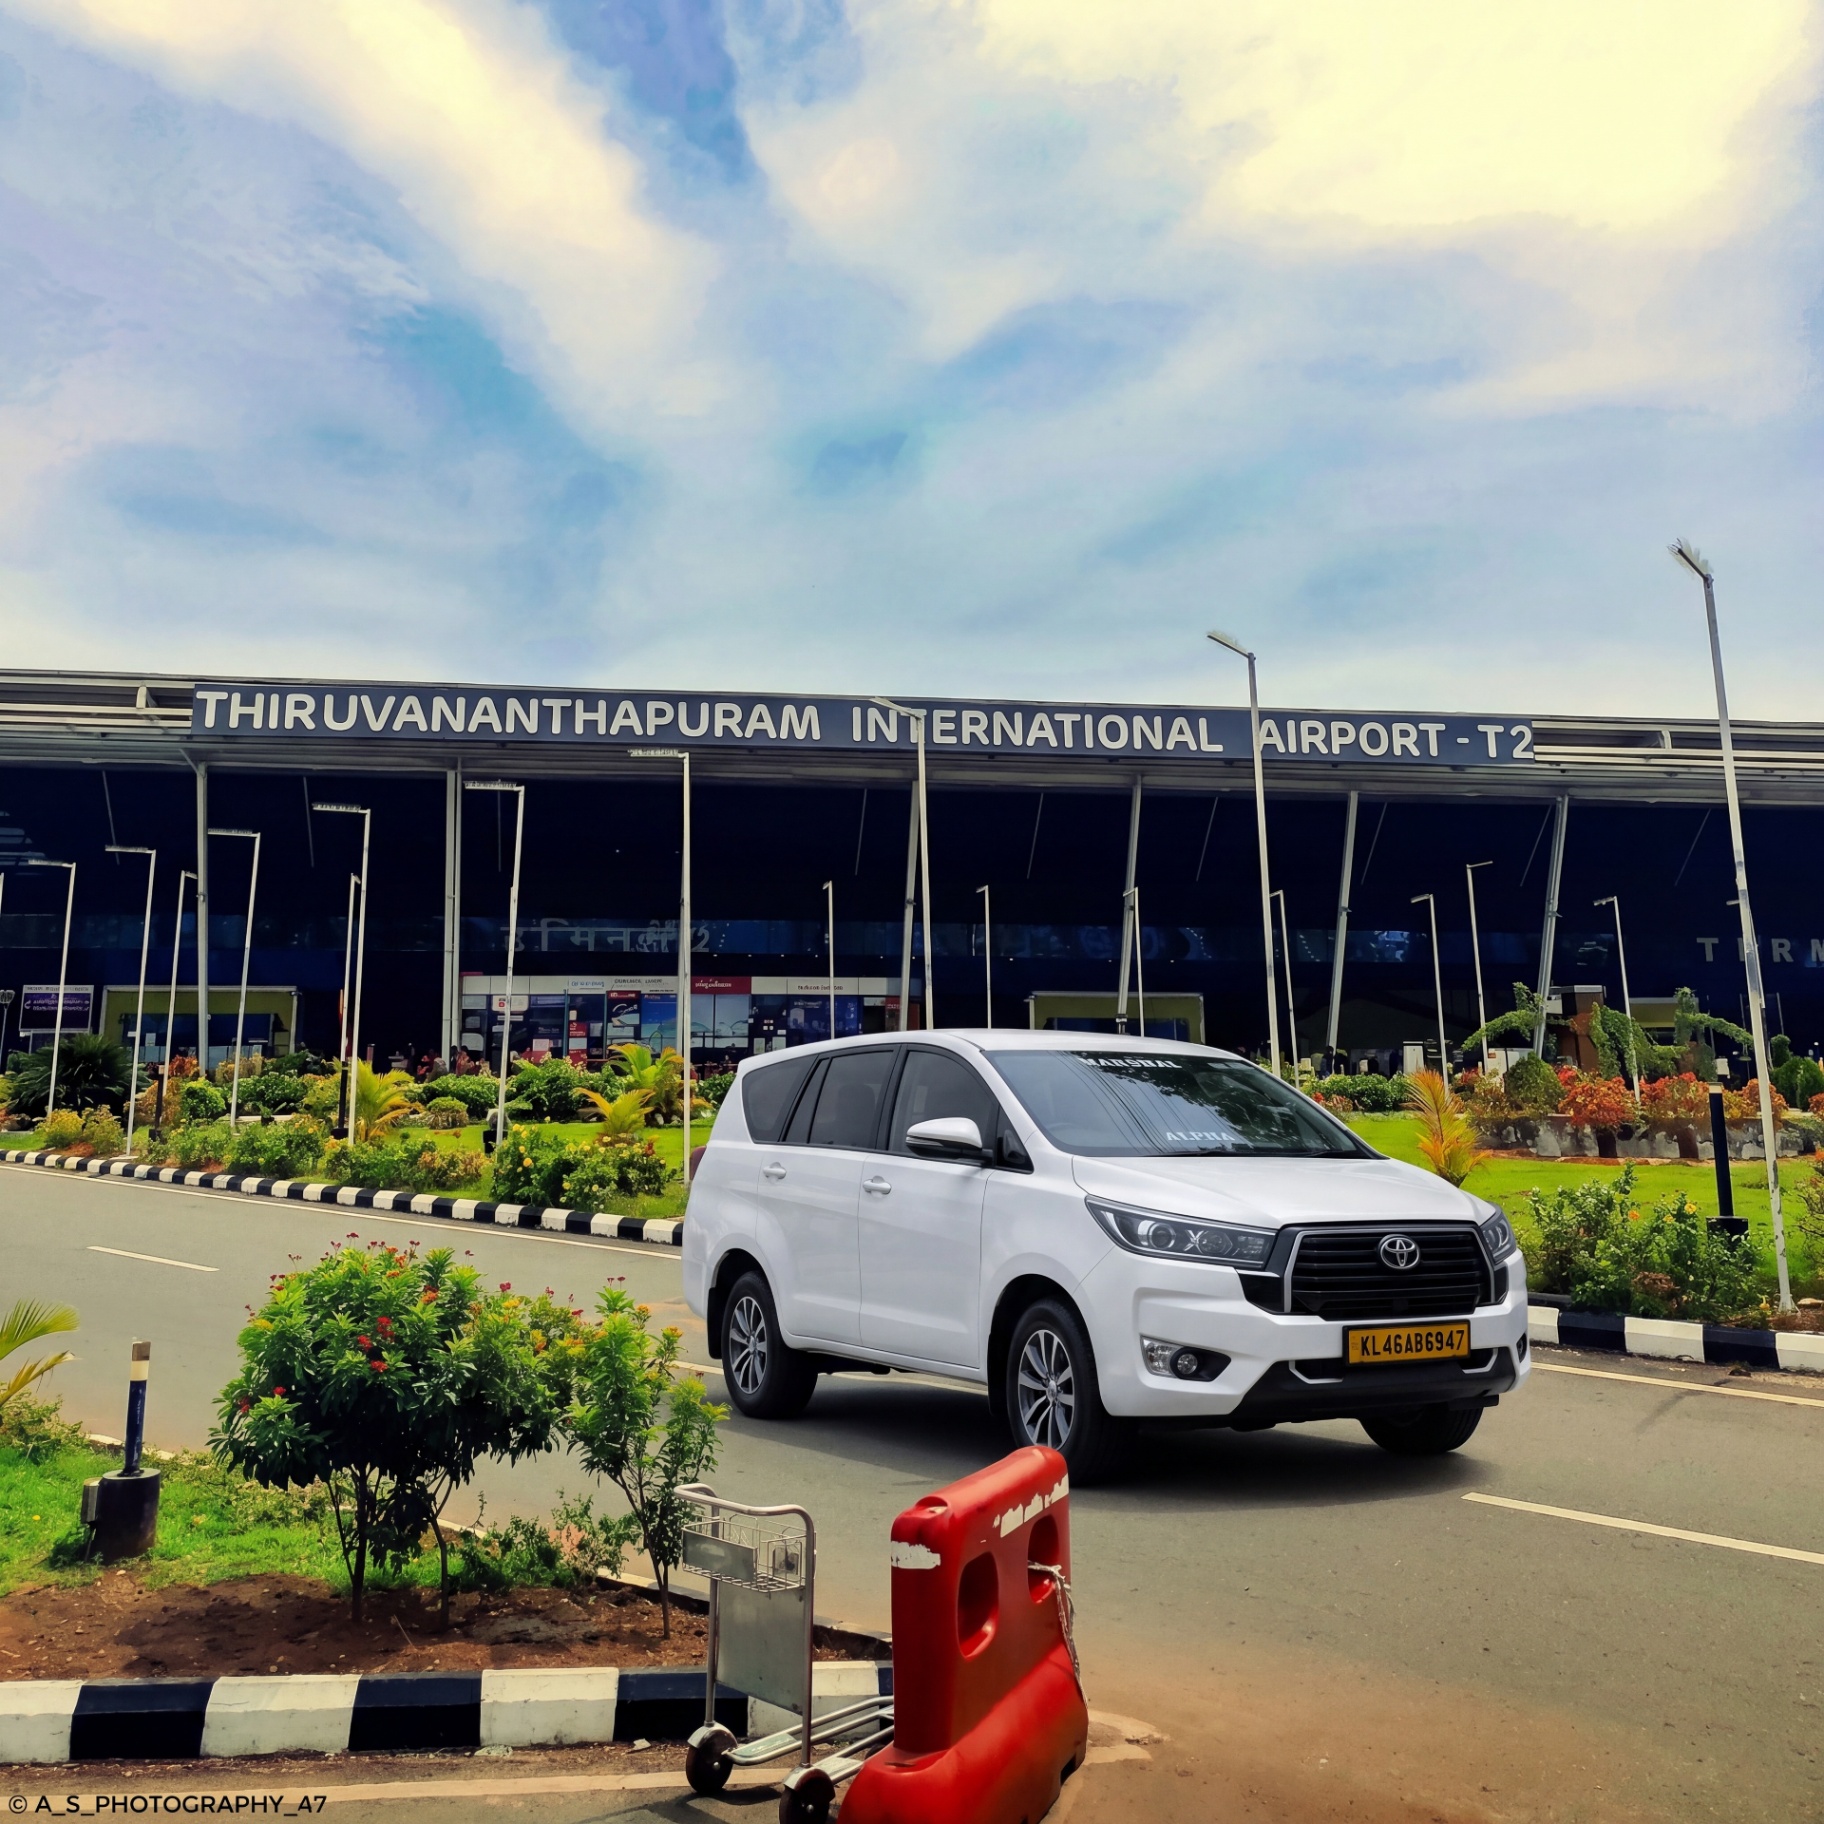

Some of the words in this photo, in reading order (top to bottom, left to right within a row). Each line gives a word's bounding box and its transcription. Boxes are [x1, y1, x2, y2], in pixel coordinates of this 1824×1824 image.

[196, 690, 821, 741] THIRUVANANTHAPURAM
[852, 706, 1224, 752] INTERNATIONAL
[1258, 719, 1446, 757] AIRPORT
[1696, 937, 1824, 963] TRM
[1360, 1330, 1465, 1356] KL46AB6947
